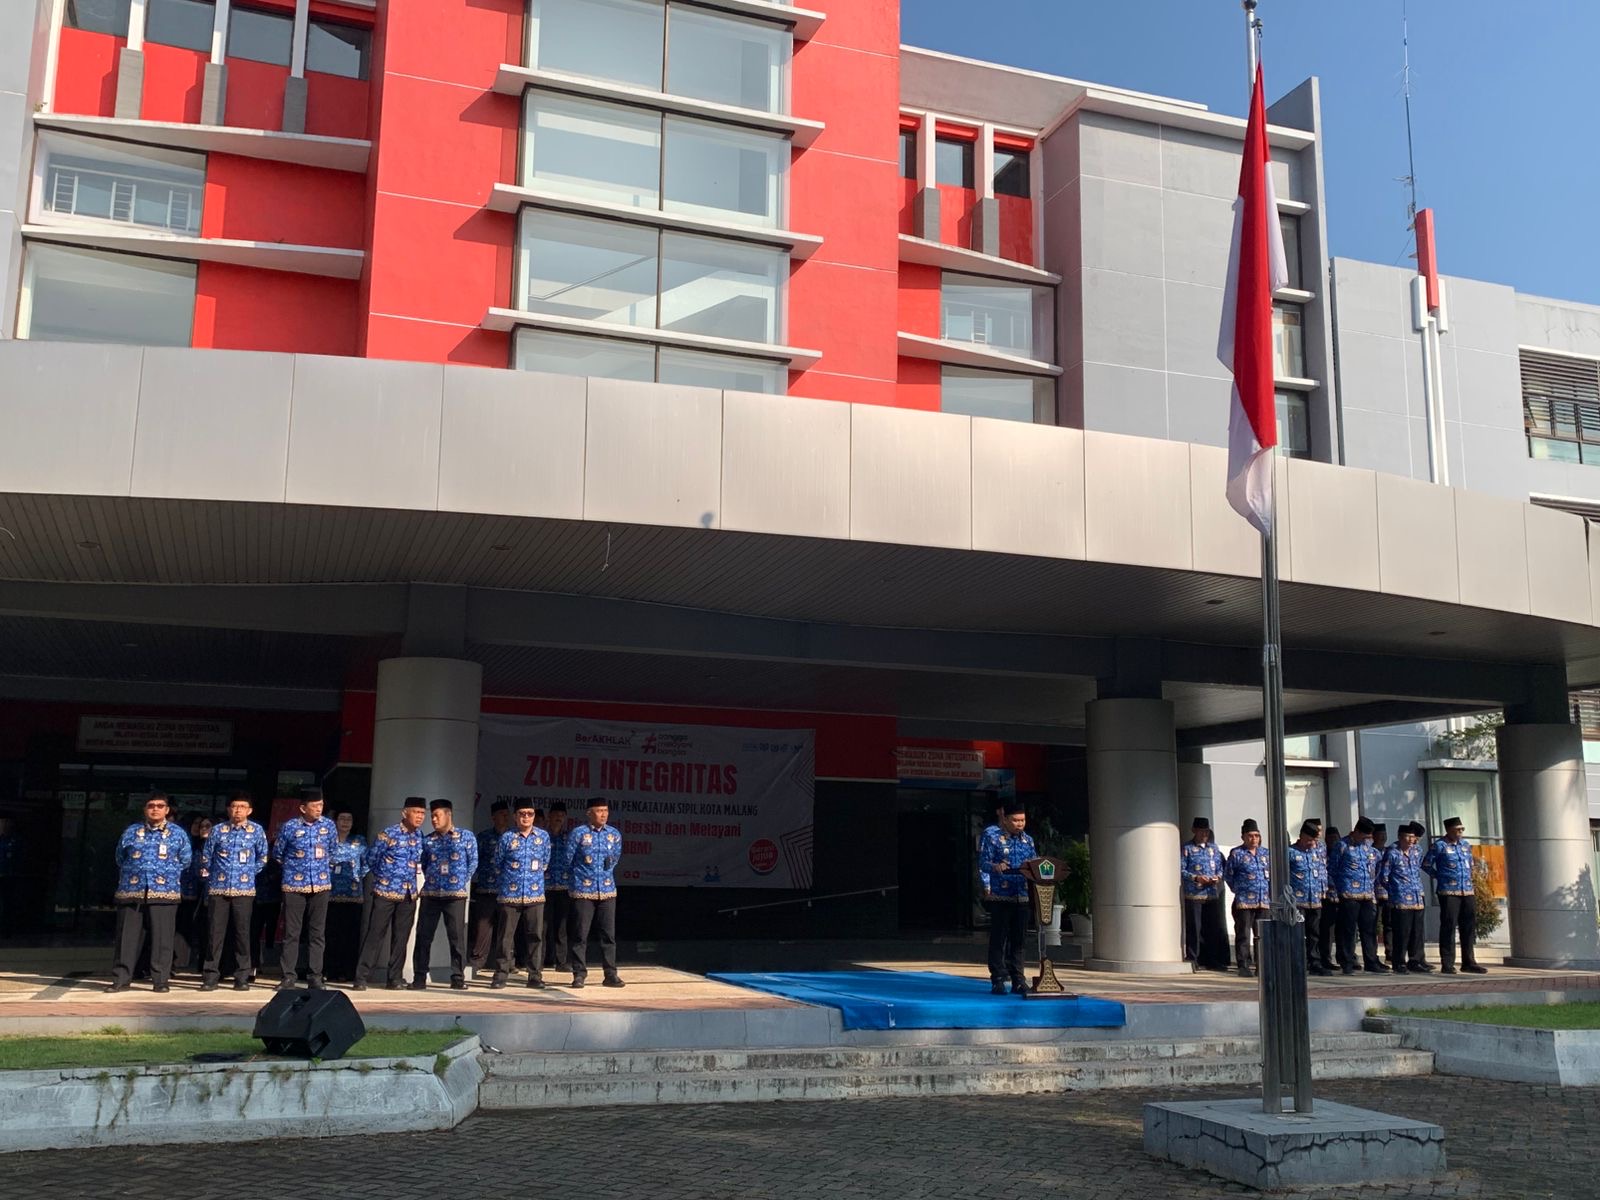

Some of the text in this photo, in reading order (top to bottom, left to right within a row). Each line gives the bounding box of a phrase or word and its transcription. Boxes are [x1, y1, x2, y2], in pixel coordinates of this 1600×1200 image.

[523, 755, 737, 795] ZONA INTEGRITAS
[621, 800, 676, 815] PENCATATAN
[677, 802, 698, 815] SIPIL
[700, 803, 722, 816] KOTA
[723, 804, 758, 817] MALANG
[624, 820, 662, 834] Bersih
[665, 822, 686, 836] dan
[689, 823, 742, 839] Melayani
